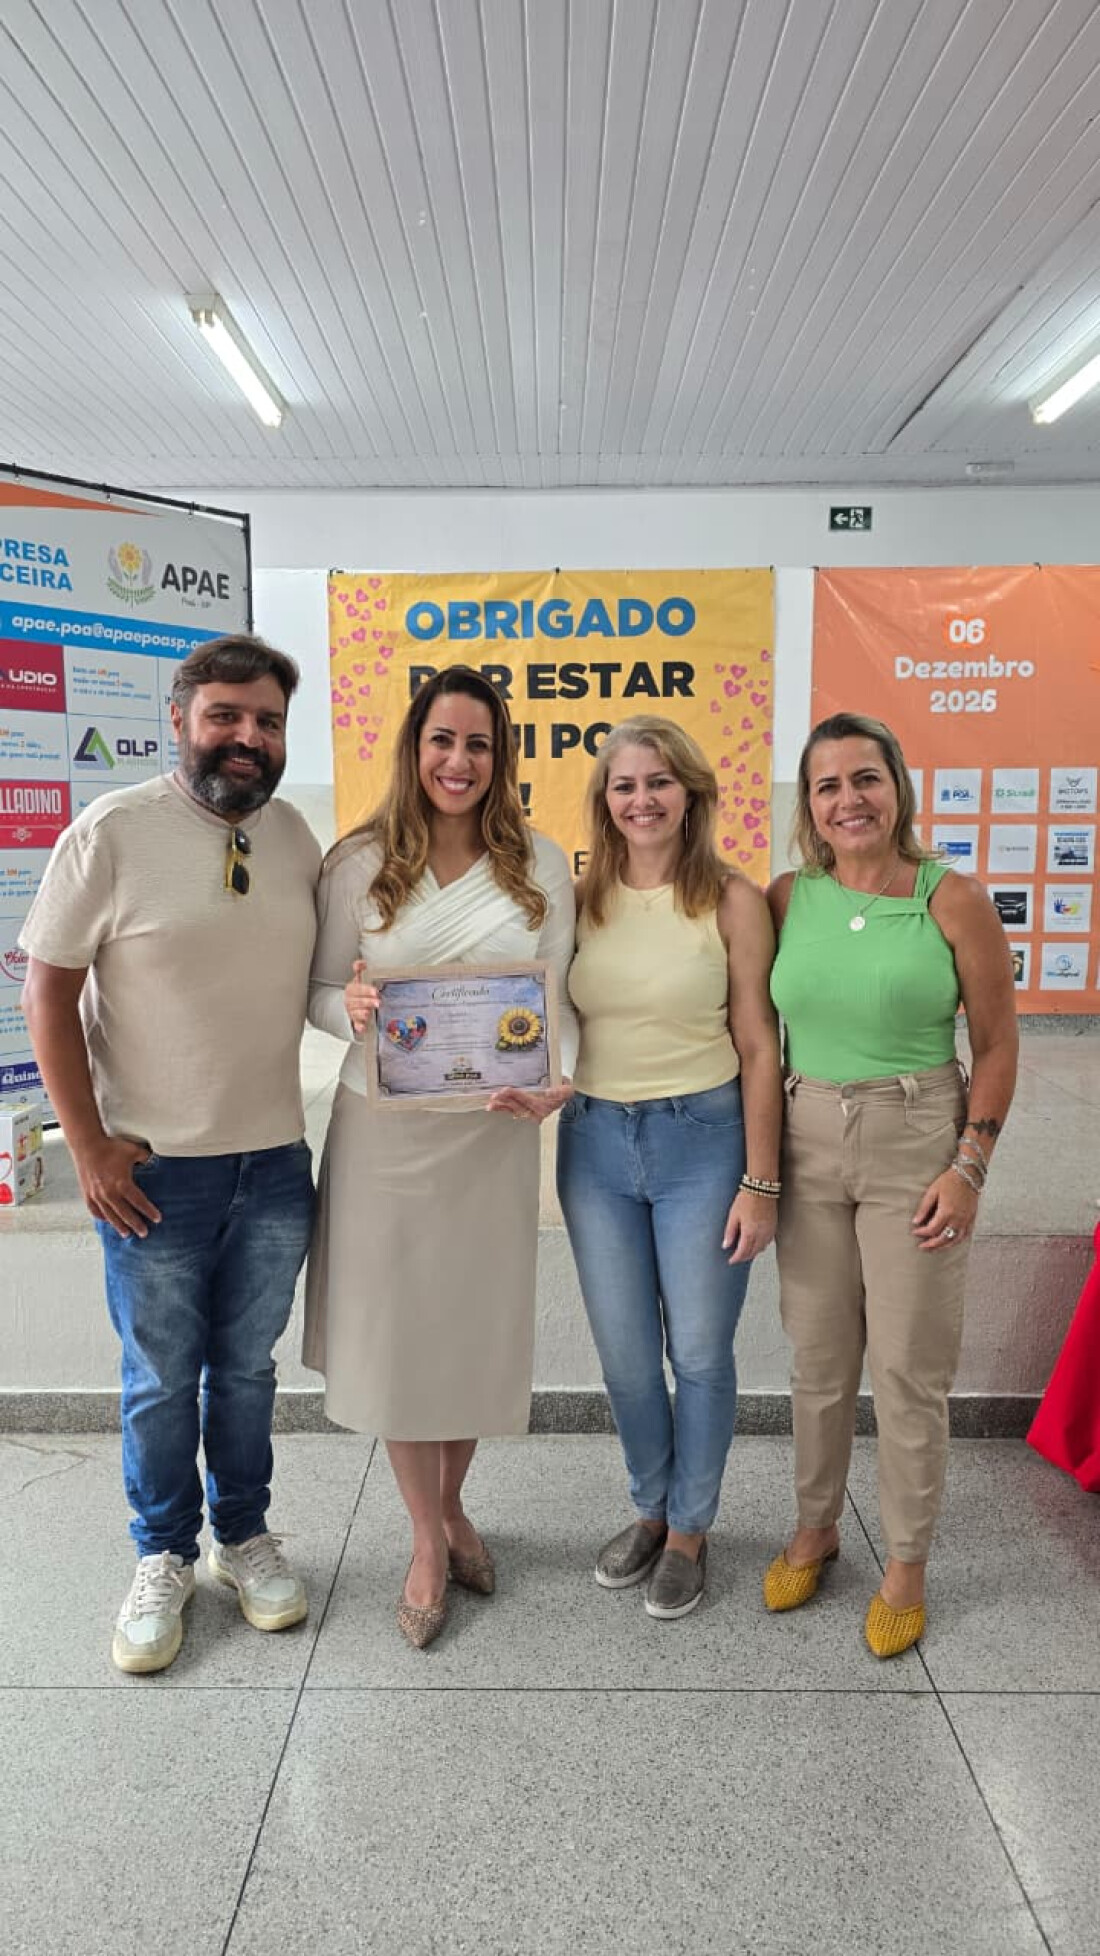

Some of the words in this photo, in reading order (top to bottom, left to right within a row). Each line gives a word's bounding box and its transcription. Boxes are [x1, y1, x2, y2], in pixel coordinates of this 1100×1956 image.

[0, 538, 70, 567] RESA
[161, 563, 230, 599] APAE
[406, 597, 697, 640] OBRIGADO
[949, 618, 986, 644] 06
[526, 661, 696, 699] ESTAR
[894, 654, 1035, 679] Dezembro
[117, 738, 158, 757] OLP
